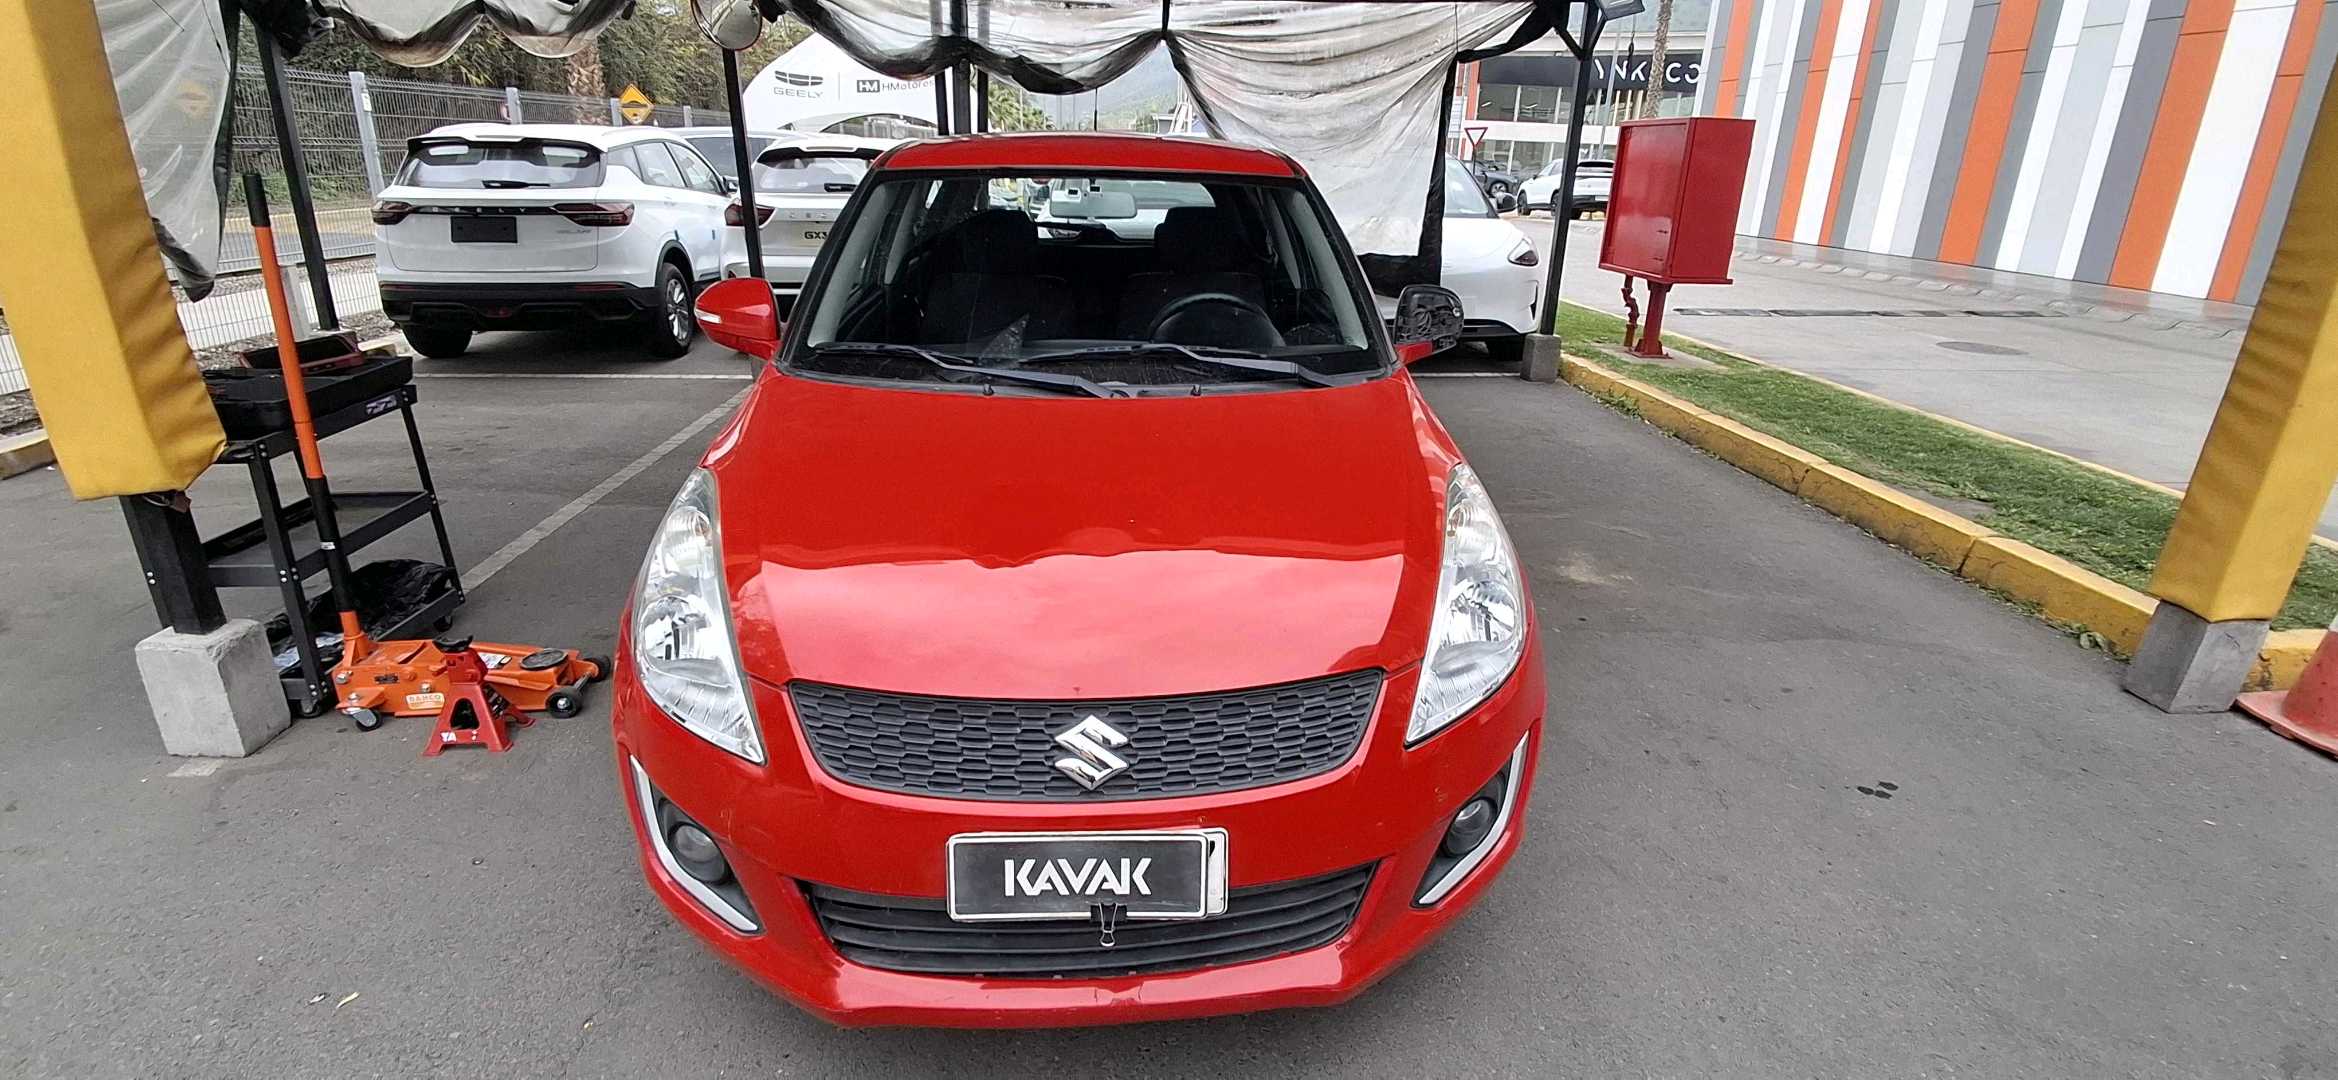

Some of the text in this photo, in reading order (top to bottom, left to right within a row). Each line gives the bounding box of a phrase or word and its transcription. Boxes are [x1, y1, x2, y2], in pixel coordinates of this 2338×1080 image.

[773, 86, 823, 98] GEELY
[858, 81, 879, 92] HM
[1004, 857, 1152, 897] KAVAK
